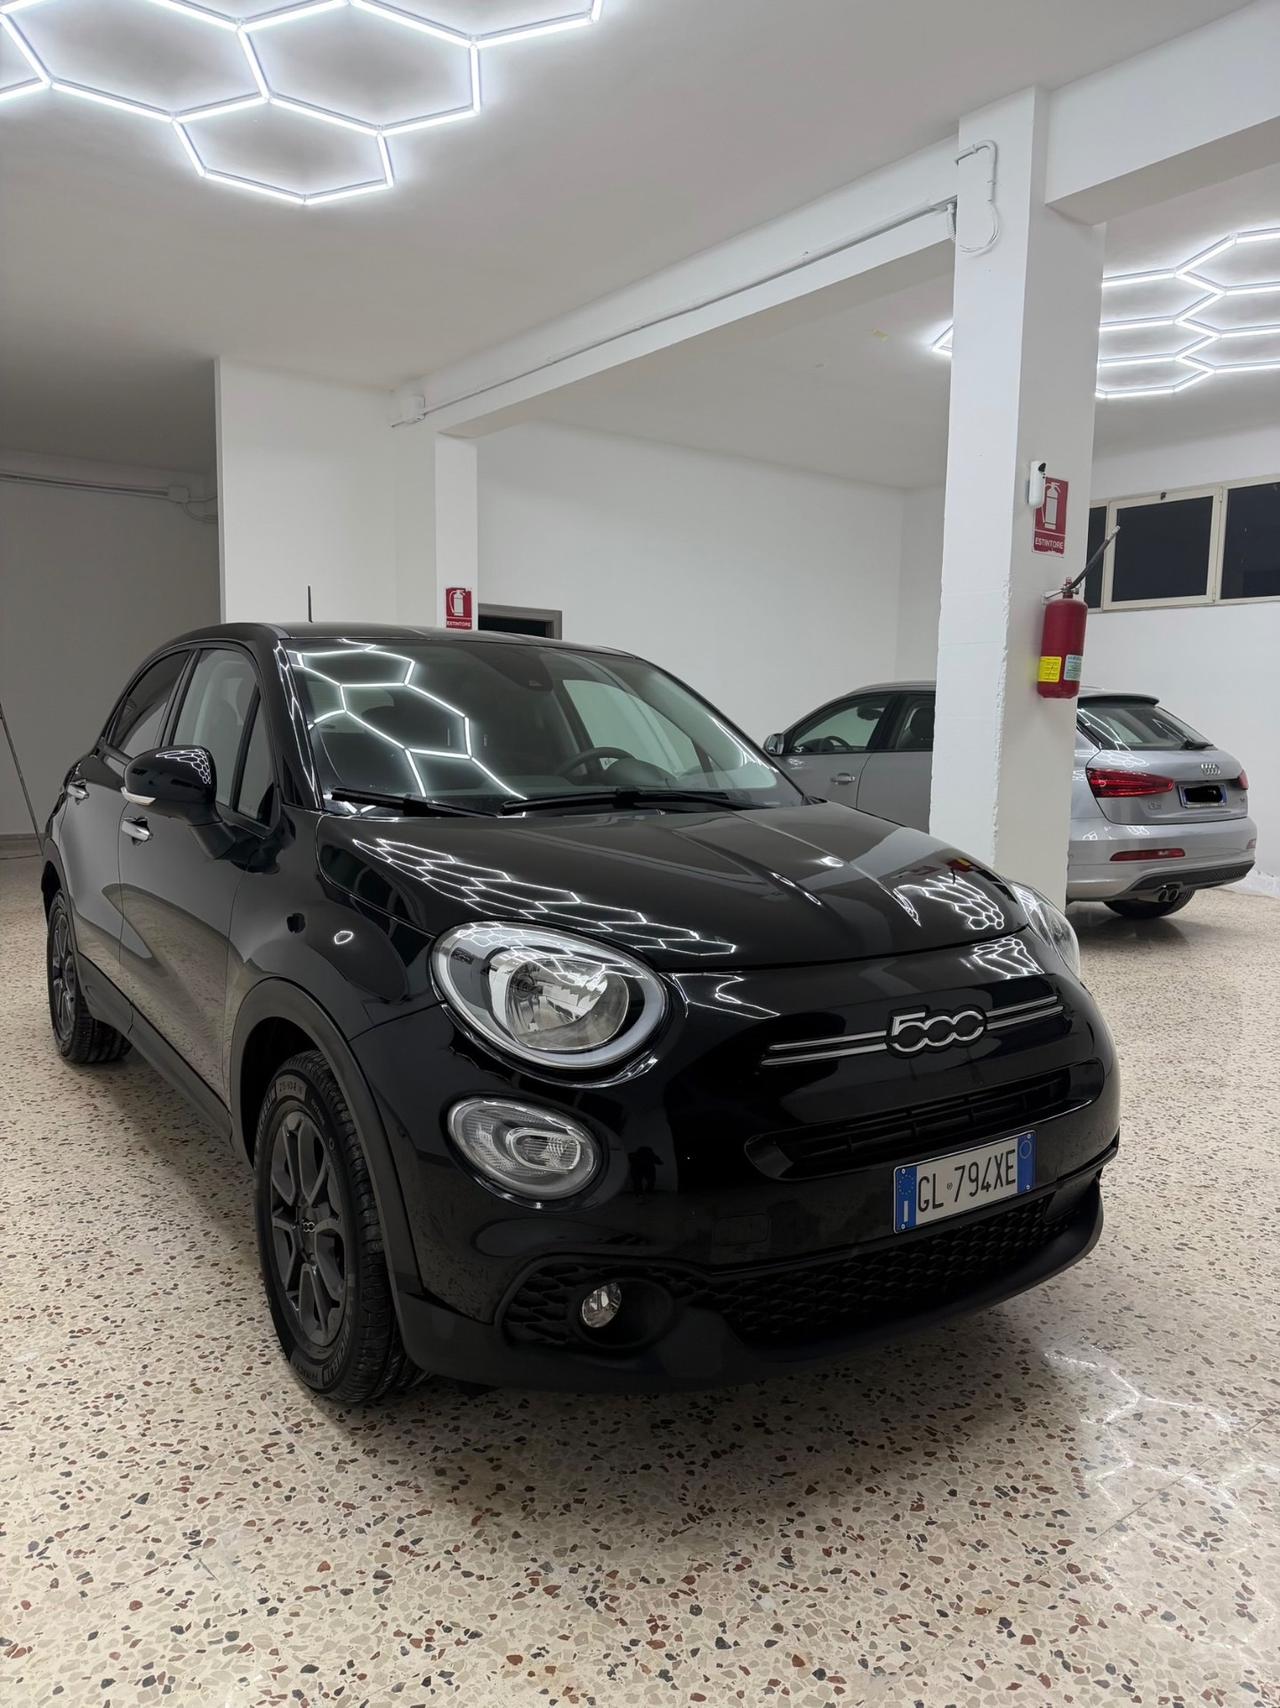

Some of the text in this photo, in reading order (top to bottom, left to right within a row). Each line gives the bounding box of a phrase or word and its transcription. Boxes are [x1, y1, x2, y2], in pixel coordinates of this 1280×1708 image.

[1035, 537, 1064, 549] ESTINTORE
[890, 1010, 984, 1052] 500
[917, 1149, 1016, 1212] GL 794XE
